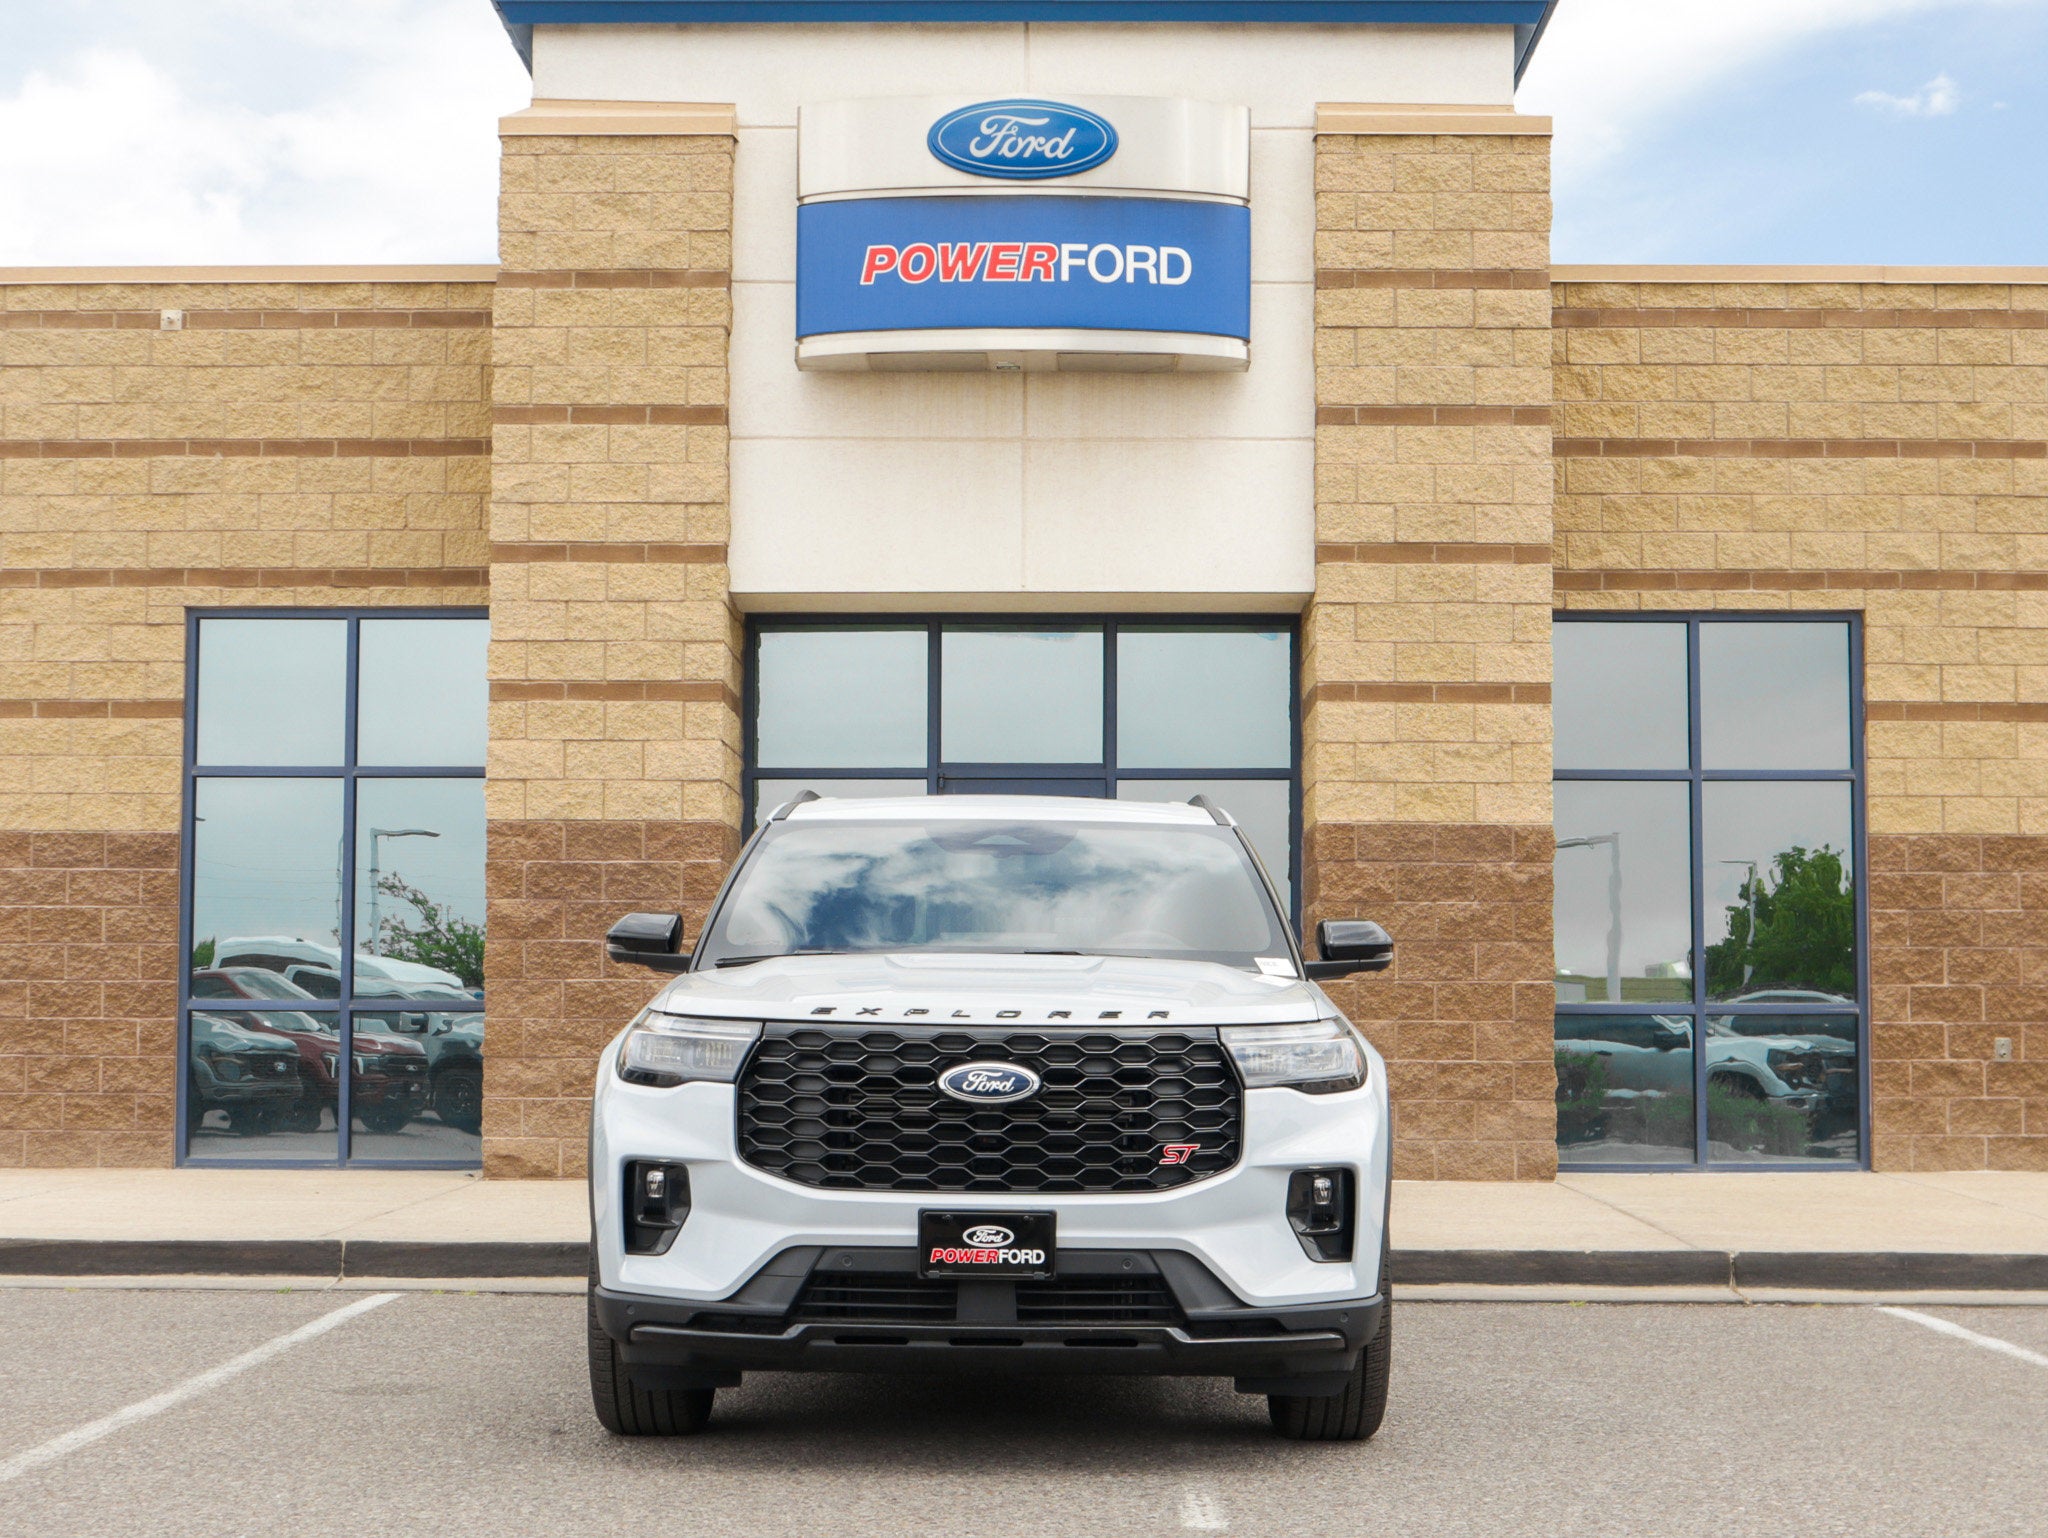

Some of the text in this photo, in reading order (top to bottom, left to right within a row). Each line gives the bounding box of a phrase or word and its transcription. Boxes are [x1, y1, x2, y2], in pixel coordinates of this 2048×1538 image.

[969, 114, 1077, 160] Ford
[810, 1006, 1171, 1019] EXPLORER
[961, 1069, 1015, 1093] Ford
[1159, 1143, 1201, 1165] ST
